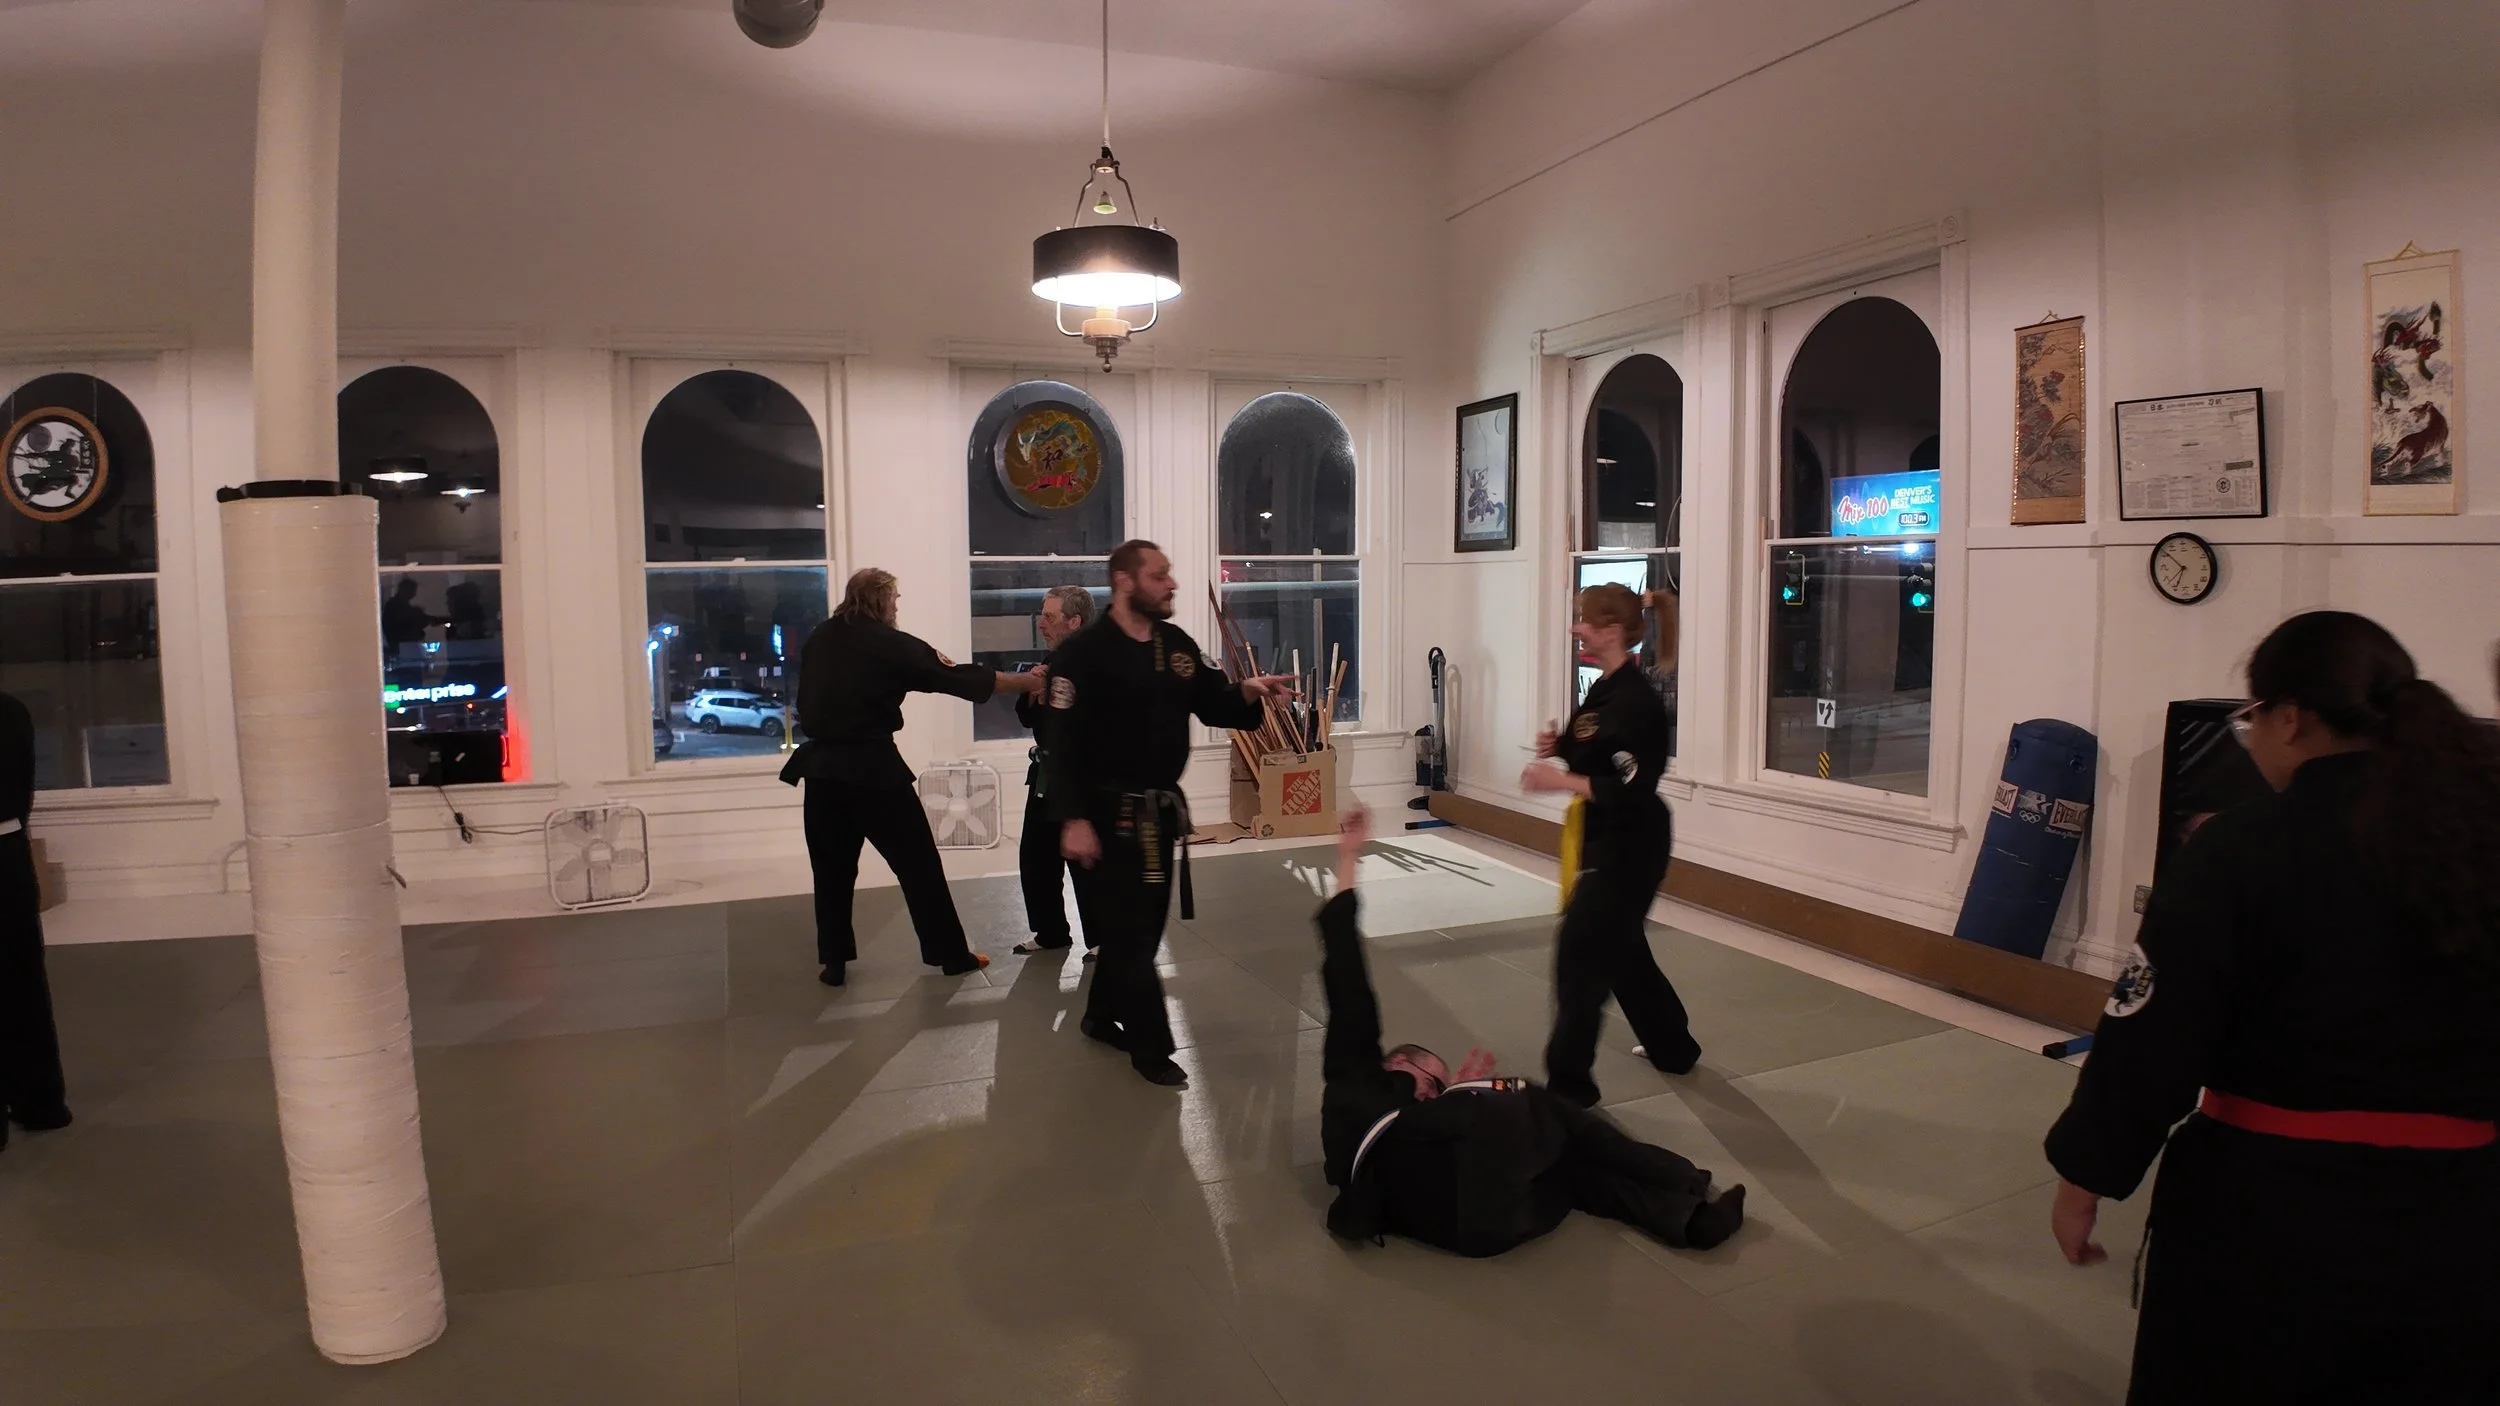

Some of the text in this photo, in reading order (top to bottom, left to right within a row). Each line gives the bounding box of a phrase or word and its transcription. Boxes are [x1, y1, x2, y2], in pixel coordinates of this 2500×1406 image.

[1894, 485, 1932, 497] DENVER'S
[1838, 495, 1890, 525] Mix 100
[1890, 494, 1935, 509] BEST MUSIC
[1900, 513, 1918, 524] 100.3
[383, 683, 476, 703] enterprise
[1281, 769, 1320, 815] HOME
[1286, 776, 1304, 794] THE
